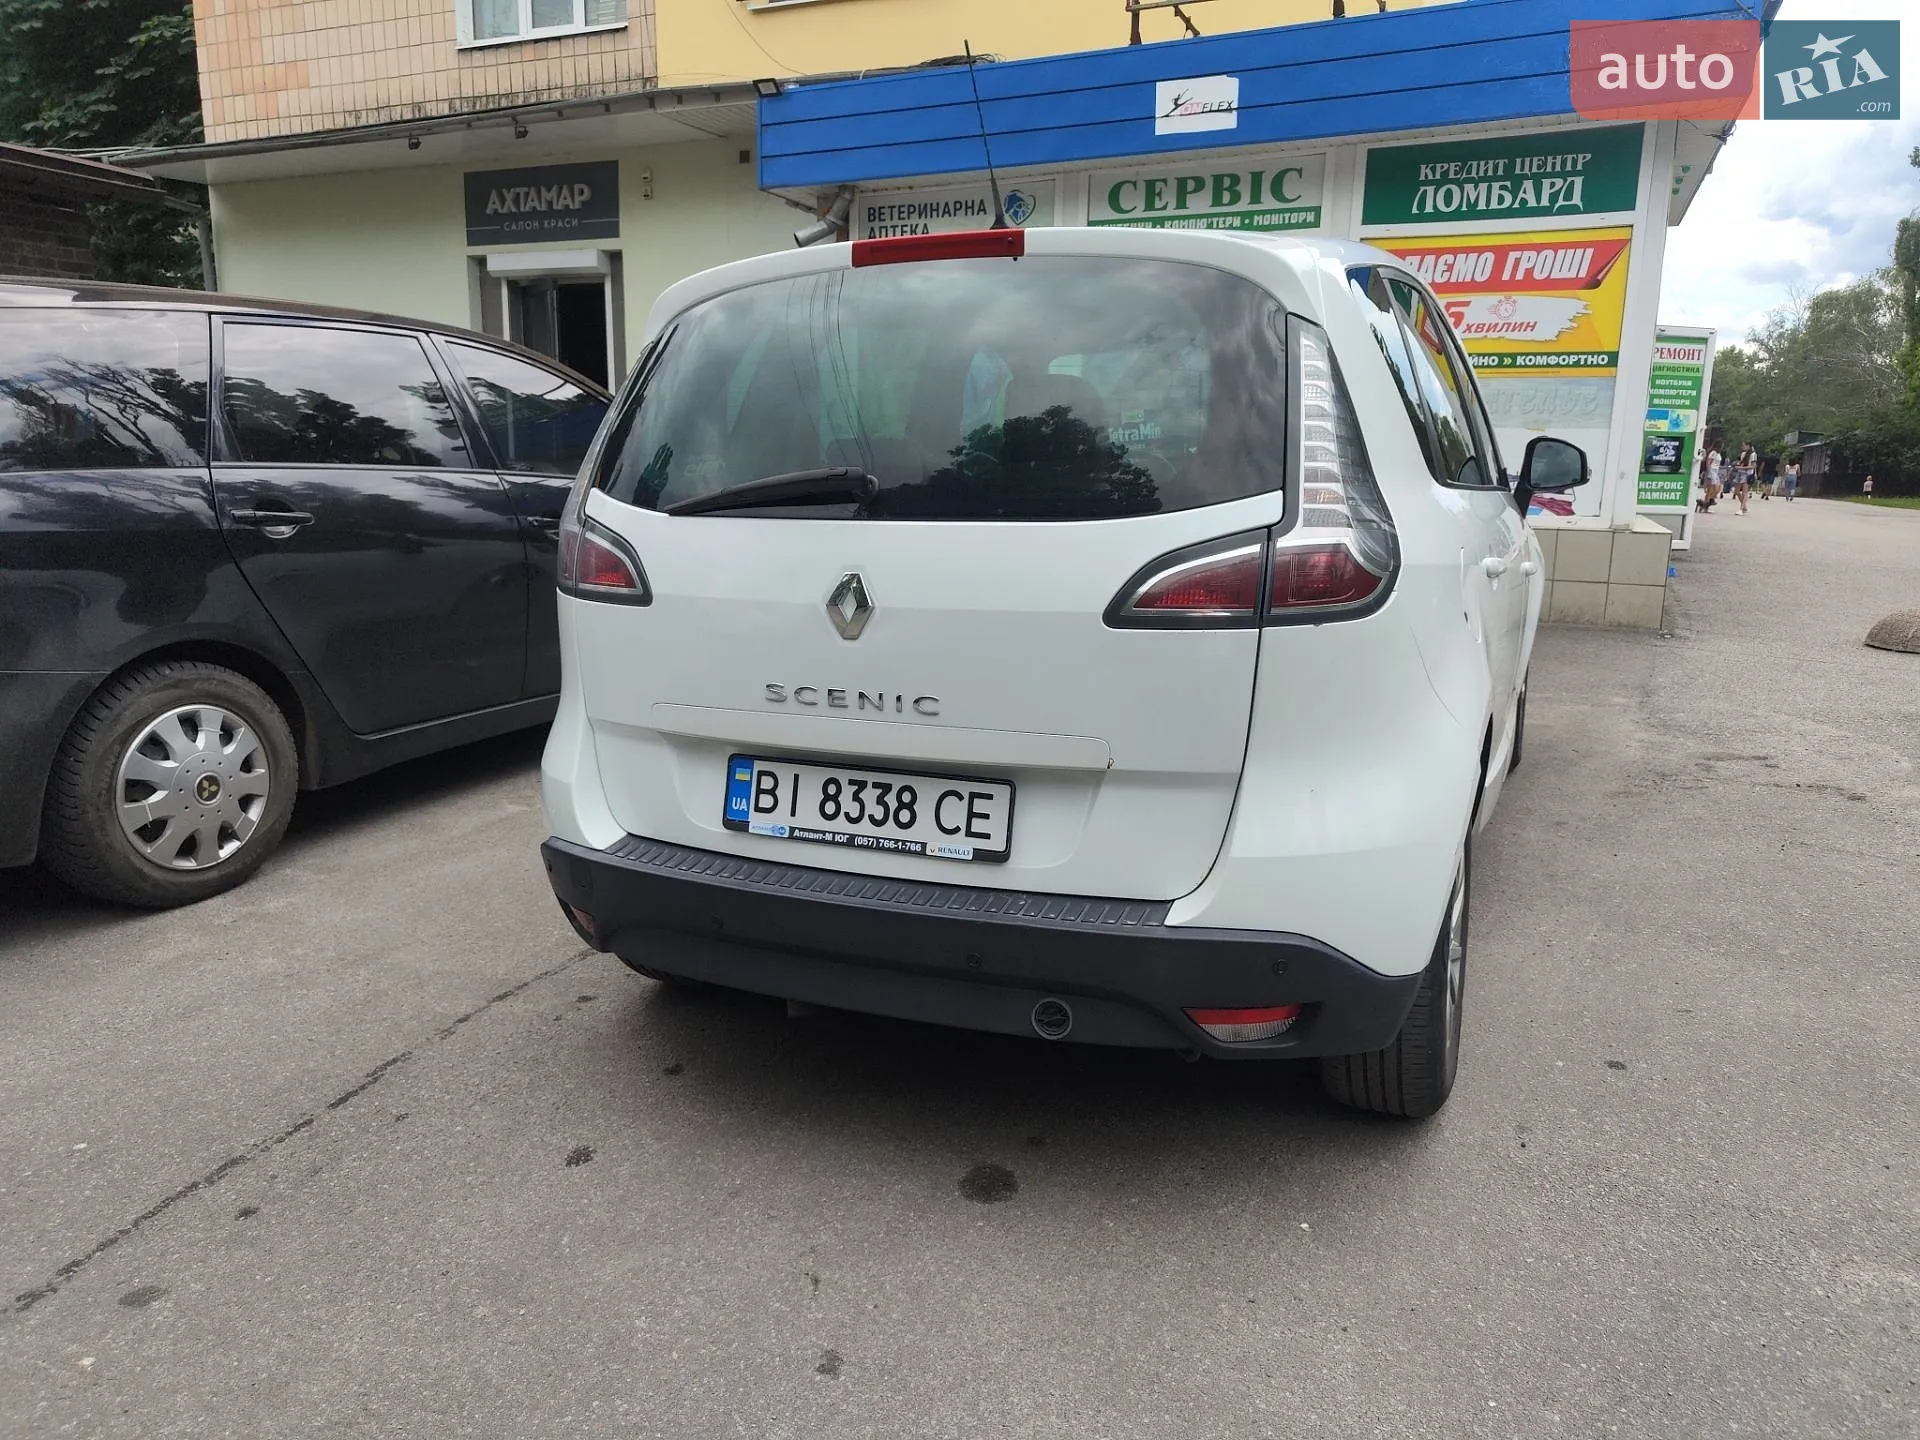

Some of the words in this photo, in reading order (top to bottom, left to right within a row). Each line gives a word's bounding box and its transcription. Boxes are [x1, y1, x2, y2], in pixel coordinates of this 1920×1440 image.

[1418, 158, 1509, 181] КРЕДИТ
[1514, 153, 1593, 176] ЦЕНТР
[485, 183, 593, 214] АХТАМАР
[1107, 166, 1303, 215] СЕРВІС
[1411, 175, 1586, 214] ЛОМБАРД
[867, 198, 988, 223] ВЕТЕРИНАРНА
[1253, 211, 1316, 226] МОНІТОРИ
[503, 220, 540, 231] САЛОН
[543, 217, 580, 229] КРАСИ
[867, 222, 930, 240] АПТЕКА
[1501, 247, 1595, 281] ГРОШІ
[1462, 320, 1538, 334] ХВИЛИН
[1515, 354, 1609, 366] КОМФОРТНО
[1639, 481, 1684, 490] КСЕРОКС
[1639, 491, 1682, 500] ЛАМІНАТ
[765, 682, 941, 716] SCENIC
[732, 797, 748, 811] UA
[754, 770, 799, 817] BI
[819, 777, 918, 830] 8338
[934, 789, 994, 840] CE
[854, 836, 877, 848] (057)
[878, 839, 922, 851] 766-1-766
[938, 847, 971, 856] RENAULT
